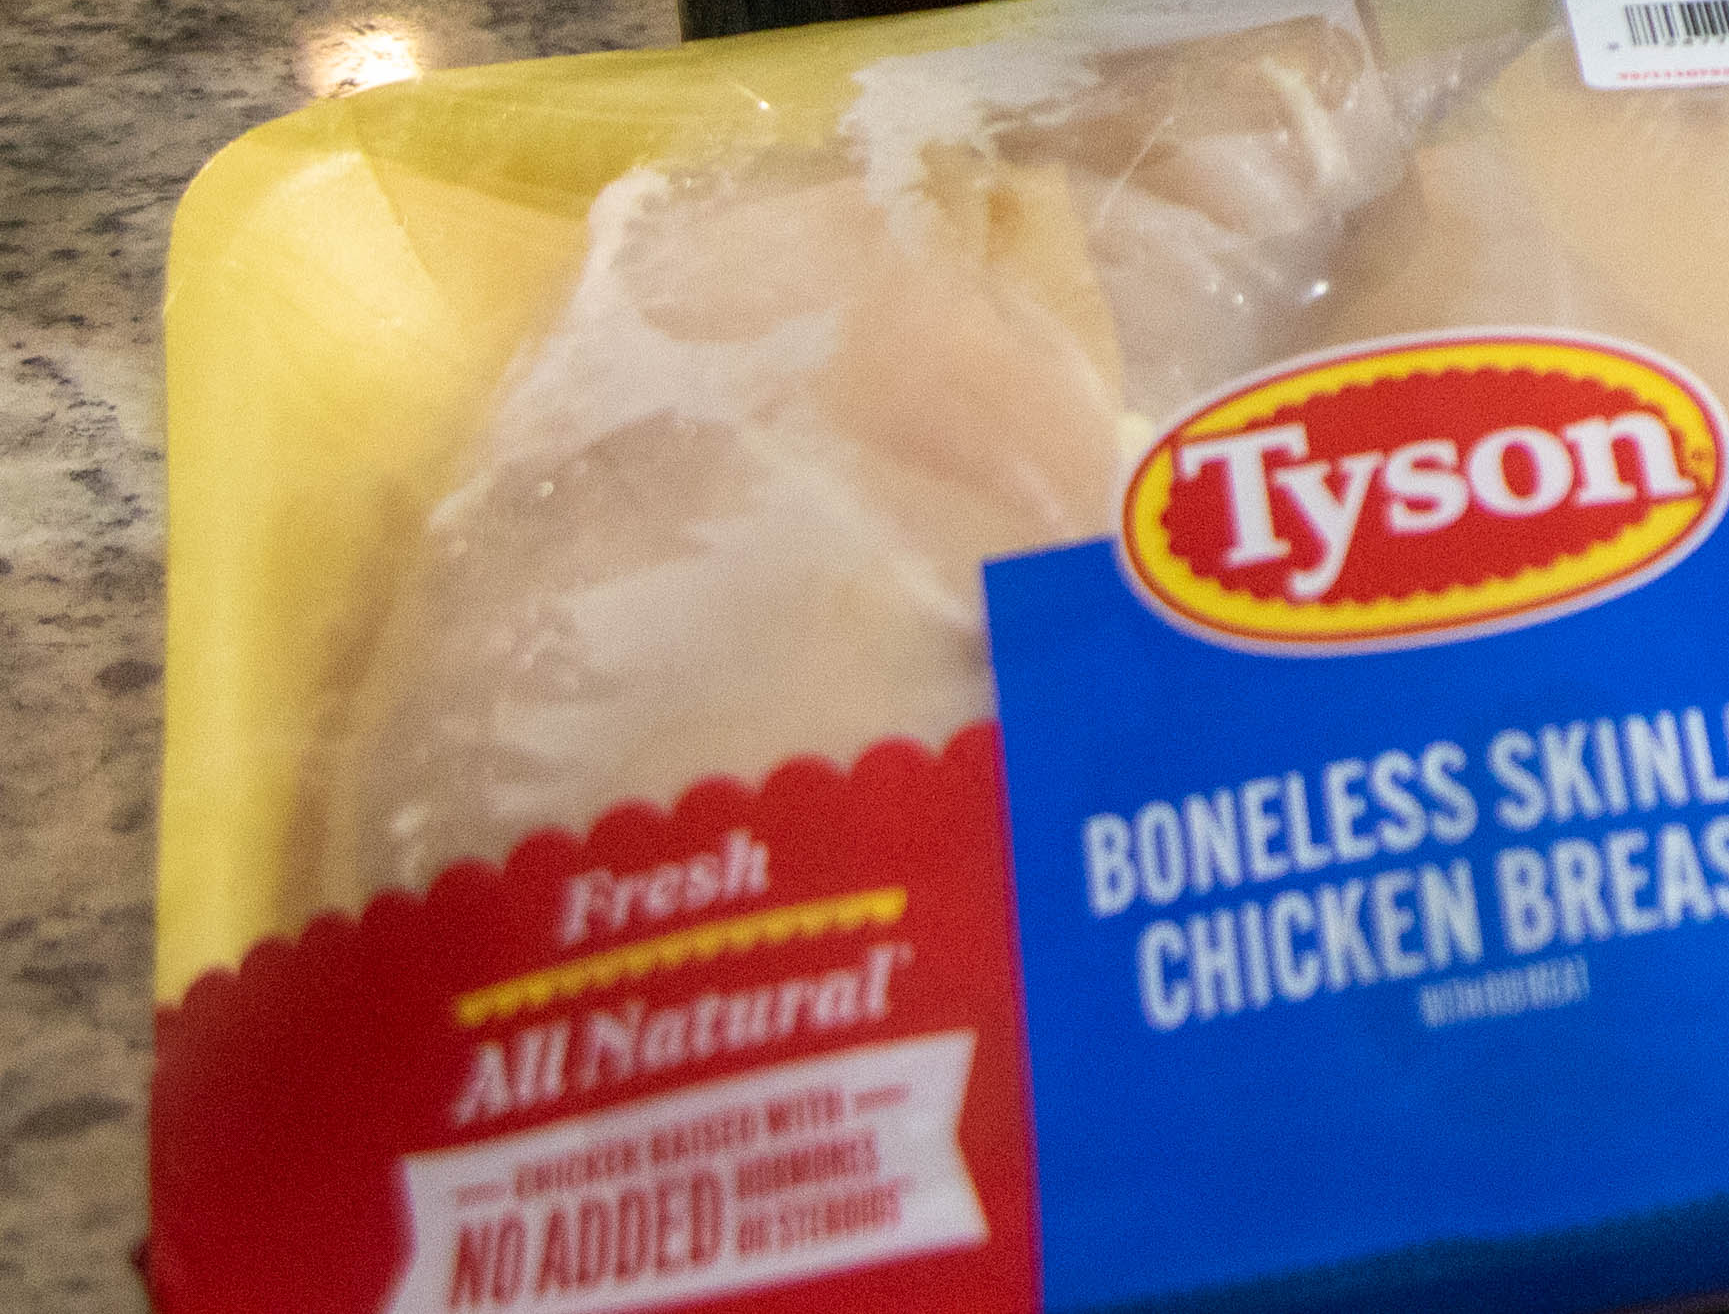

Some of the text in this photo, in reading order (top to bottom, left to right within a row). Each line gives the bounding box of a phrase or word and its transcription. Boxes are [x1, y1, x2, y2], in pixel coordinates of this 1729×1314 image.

[1177, 404, 1697, 601] Tyson
[557, 827, 770, 948] Fresh
[1083, 739, 1480, 919] BONELESS
[1133, 857, 1484, 1032] CHICKEN
[453, 942, 895, 1127] All Natural
[450, 1168, 726, 1309] NO ADDED
